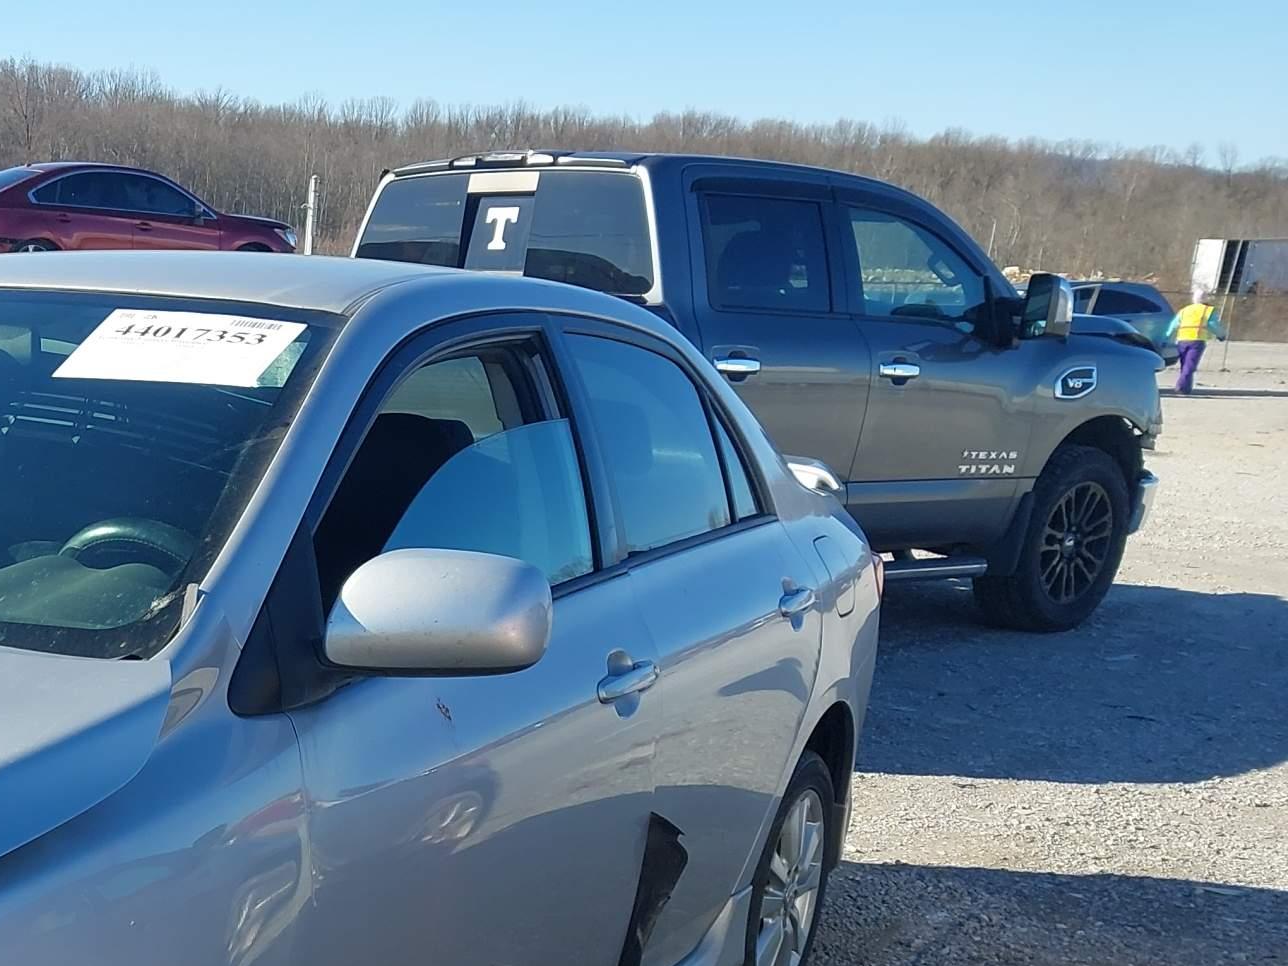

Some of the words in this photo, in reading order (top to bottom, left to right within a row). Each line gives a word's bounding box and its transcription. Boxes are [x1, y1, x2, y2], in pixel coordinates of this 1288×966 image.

[485, 206, 520, 250] T
[115, 323, 268, 346] 44017353
[1067, 378, 1082, 389] V8
[970, 451, 1018, 460] TEXAS
[958, 464, 1015, 474] TITAN
